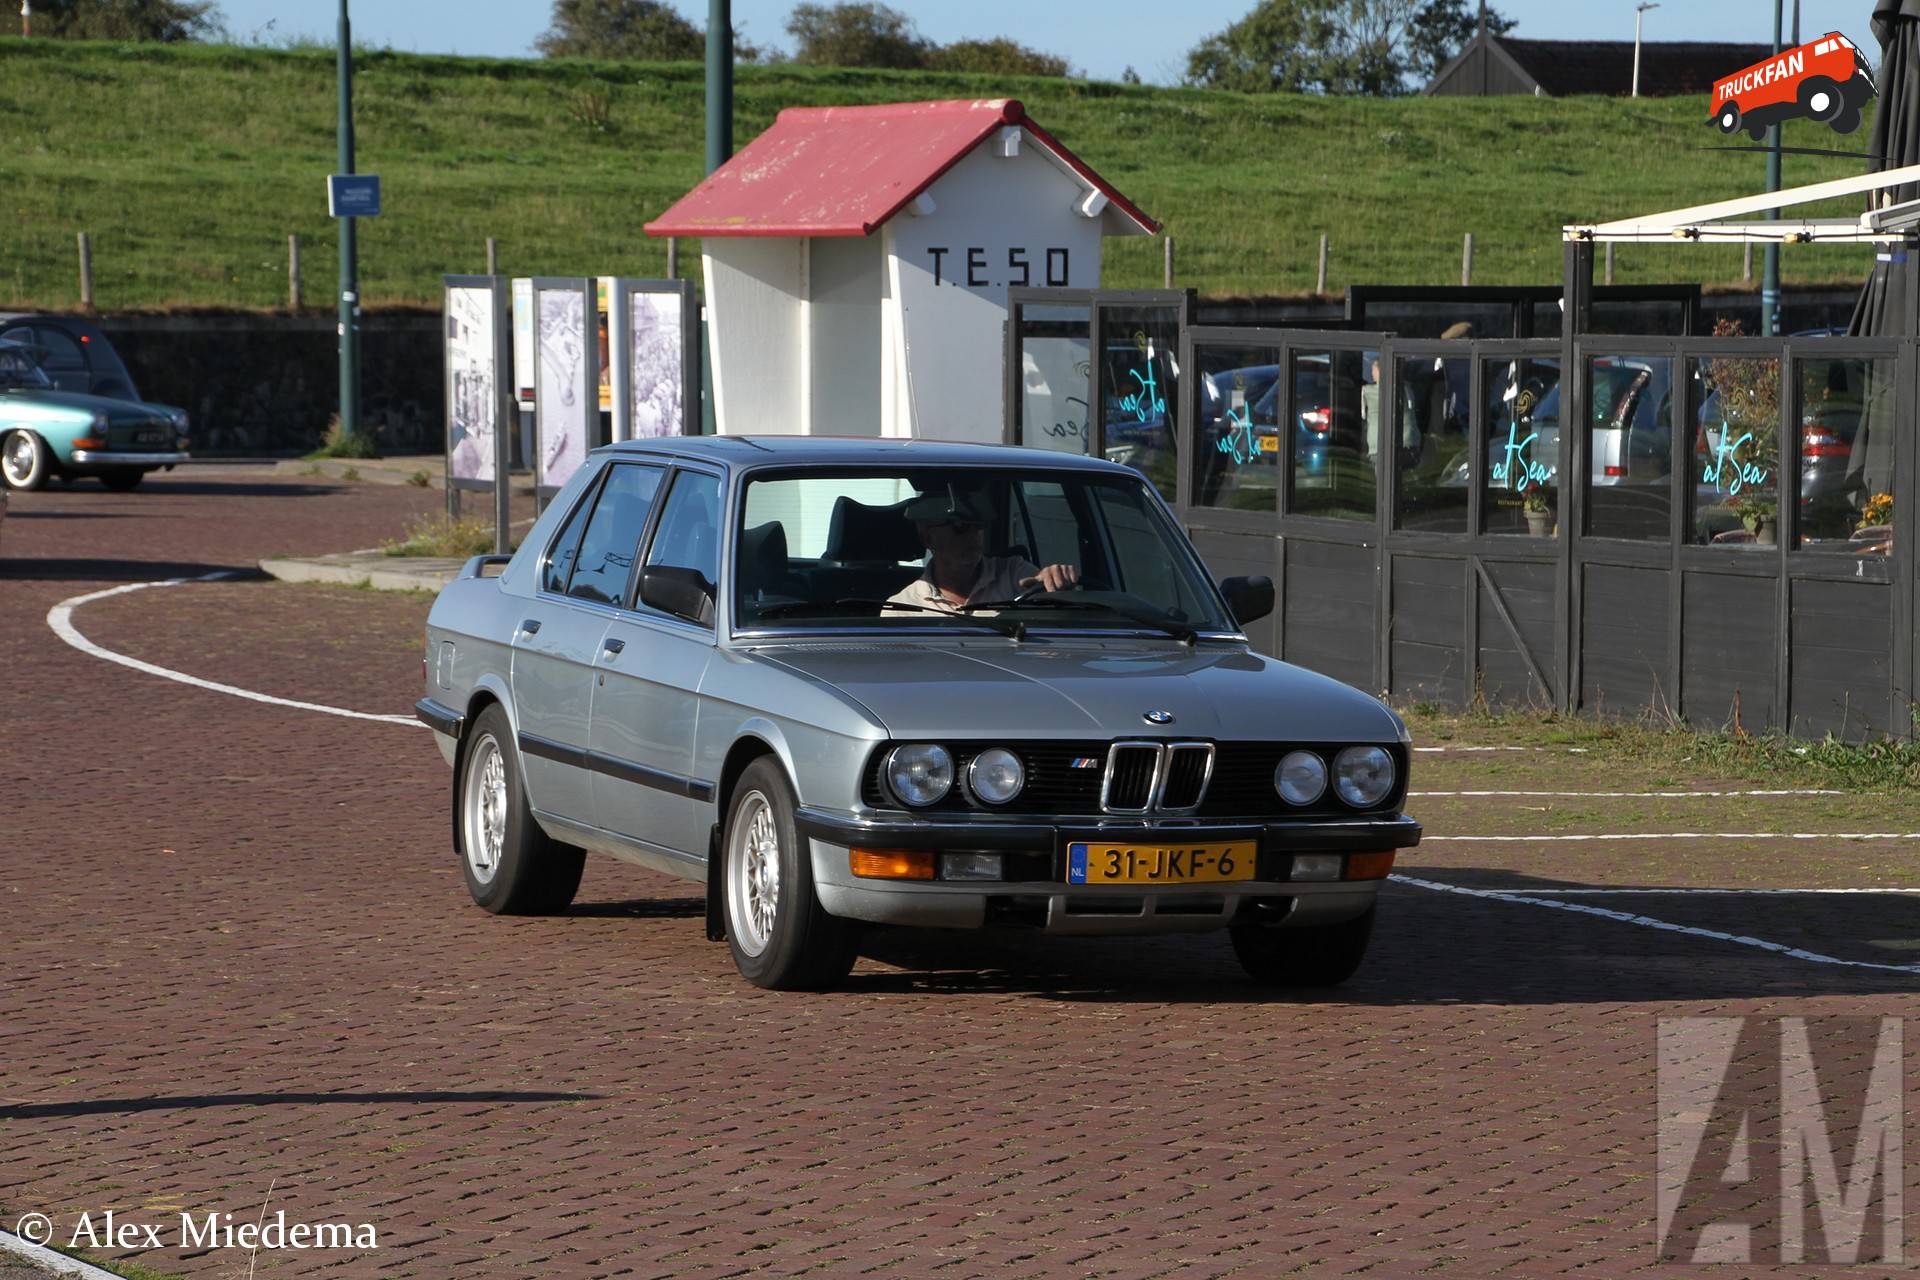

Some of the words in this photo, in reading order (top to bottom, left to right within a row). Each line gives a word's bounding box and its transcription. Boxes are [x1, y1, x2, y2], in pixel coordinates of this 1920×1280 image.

[1493, 422, 1520, 490] at
[1517, 432, 1553, 492] Sea
[1703, 421, 1732, 494] at
[1730, 432, 1768, 496] Sea
[1071, 867, 1085, 877] NL
[1103, 848, 1235, 879] 31-JKF-6
